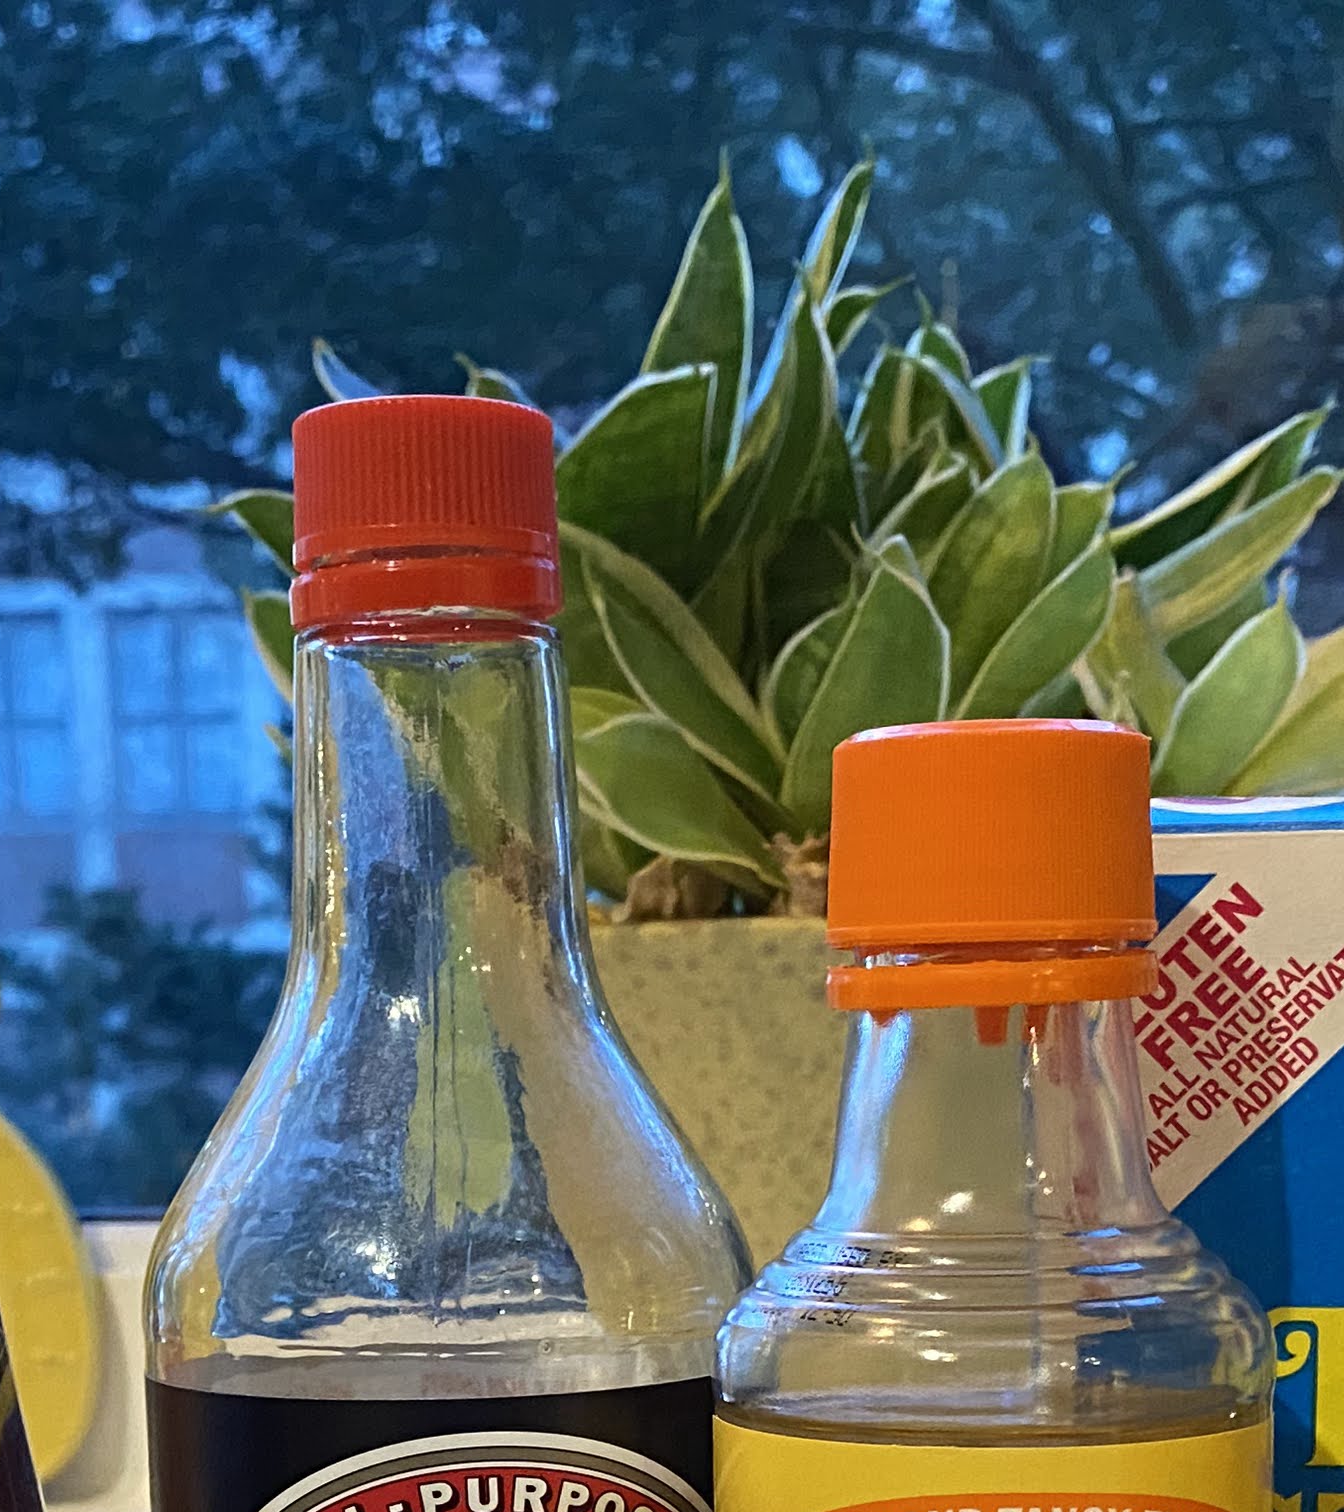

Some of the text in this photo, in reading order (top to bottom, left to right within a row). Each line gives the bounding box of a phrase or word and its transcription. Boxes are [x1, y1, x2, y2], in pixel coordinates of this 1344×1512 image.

[1135, 882, 1264, 1036] UTEN
[1140, 945, 1268, 1072] FREE
[1148, 957, 1317, 1120] ALL NATURAL
[1231, 1036, 1319, 1126] ADDED
[1145, 1112, 1191, 1172] ALT
[1186, 1078, 1231, 1121] OR
